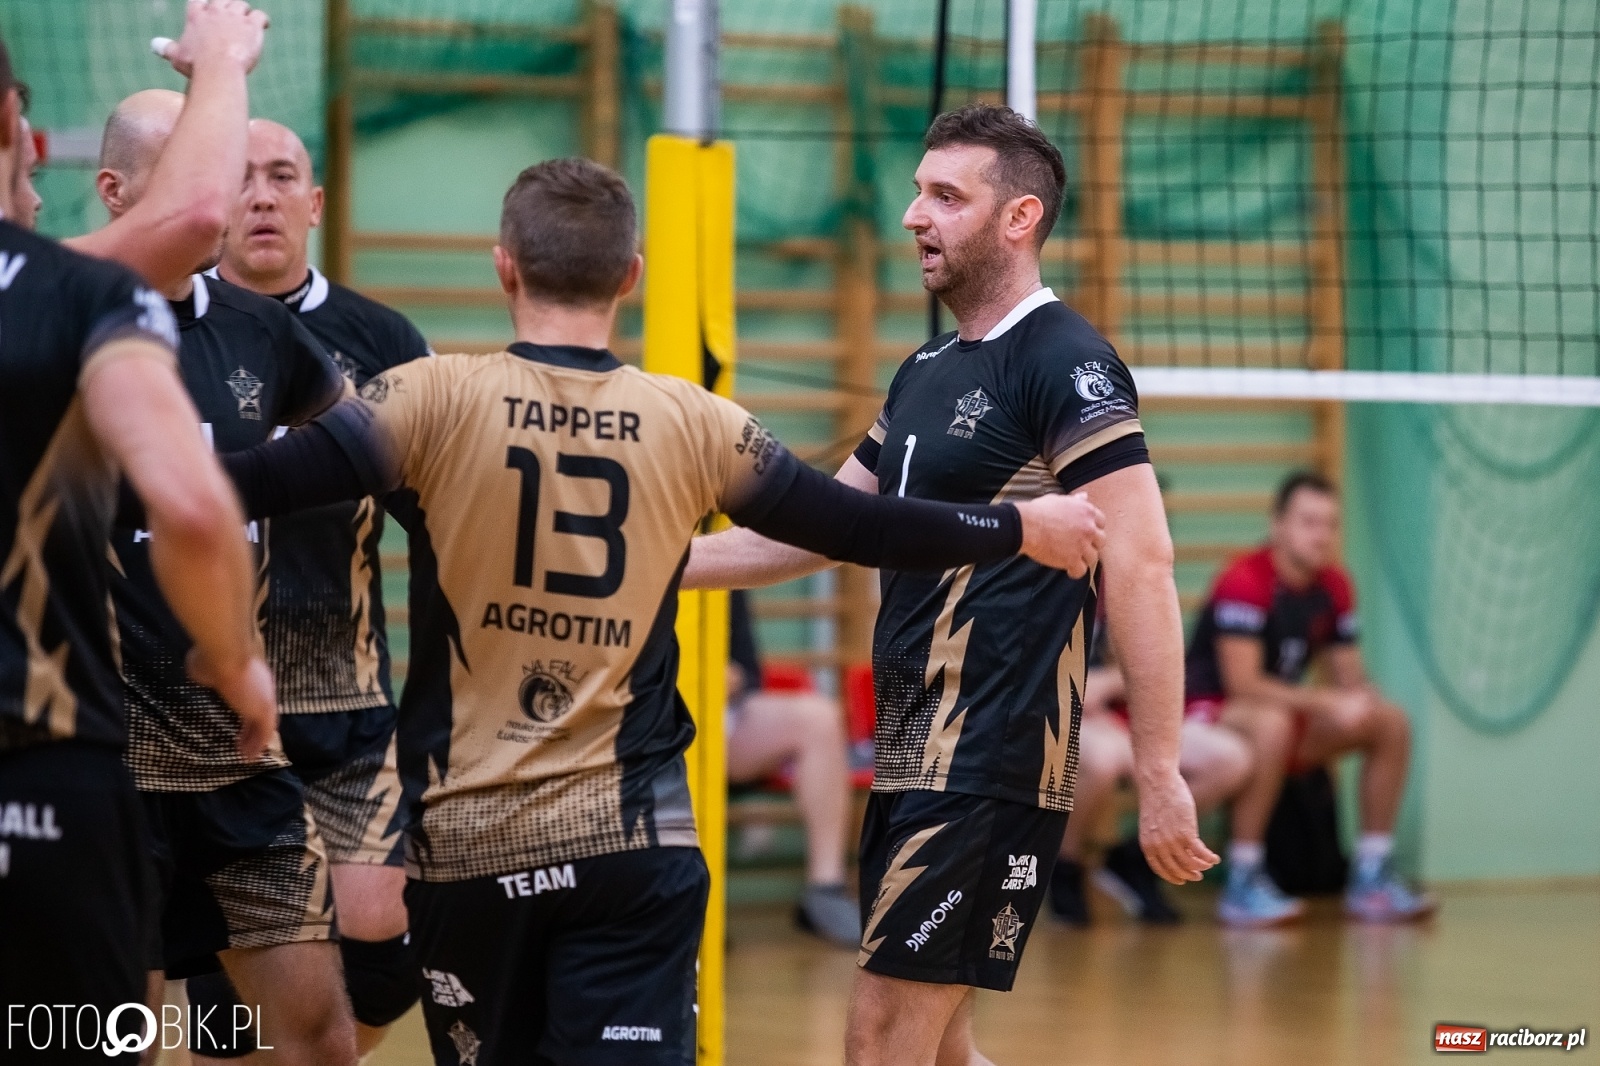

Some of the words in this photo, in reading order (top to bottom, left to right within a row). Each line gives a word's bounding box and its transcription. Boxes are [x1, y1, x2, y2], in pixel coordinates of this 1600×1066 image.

[503, 396, 641, 443] TAPPER
[506, 445, 630, 600] 13
[957, 511, 999, 528] KIPSTA
[480, 602, 632, 649] AGROTIM
[497, 863, 577, 899] TEAM
[1001, 878, 1024, 890] CARS
[905, 889, 963, 952] DAMONS
[602, 1026, 662, 1042] AGROTIM
